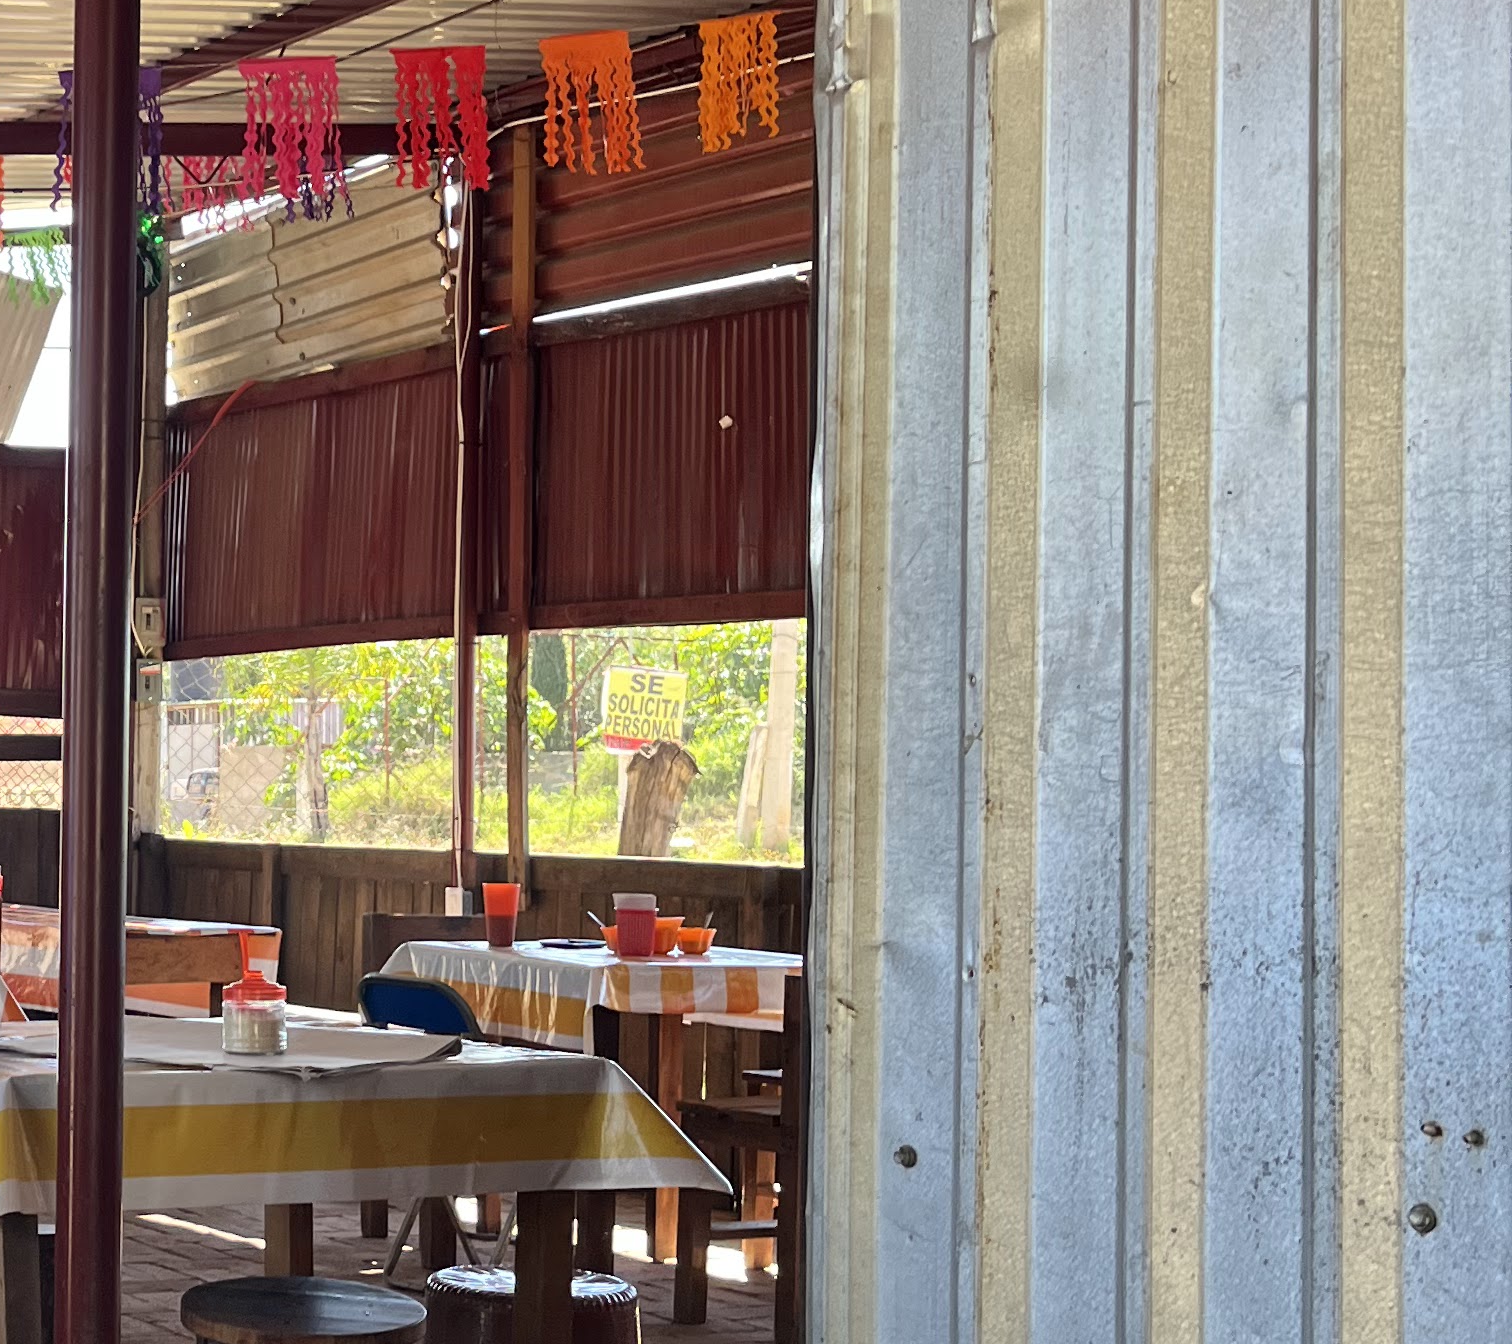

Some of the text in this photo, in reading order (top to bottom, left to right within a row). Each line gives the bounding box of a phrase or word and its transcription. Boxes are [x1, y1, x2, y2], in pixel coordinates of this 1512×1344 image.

[630, 673, 665, 695] SE
[608, 693, 681, 719] SOLICITA
[605, 714, 680, 740] PERSONAL
